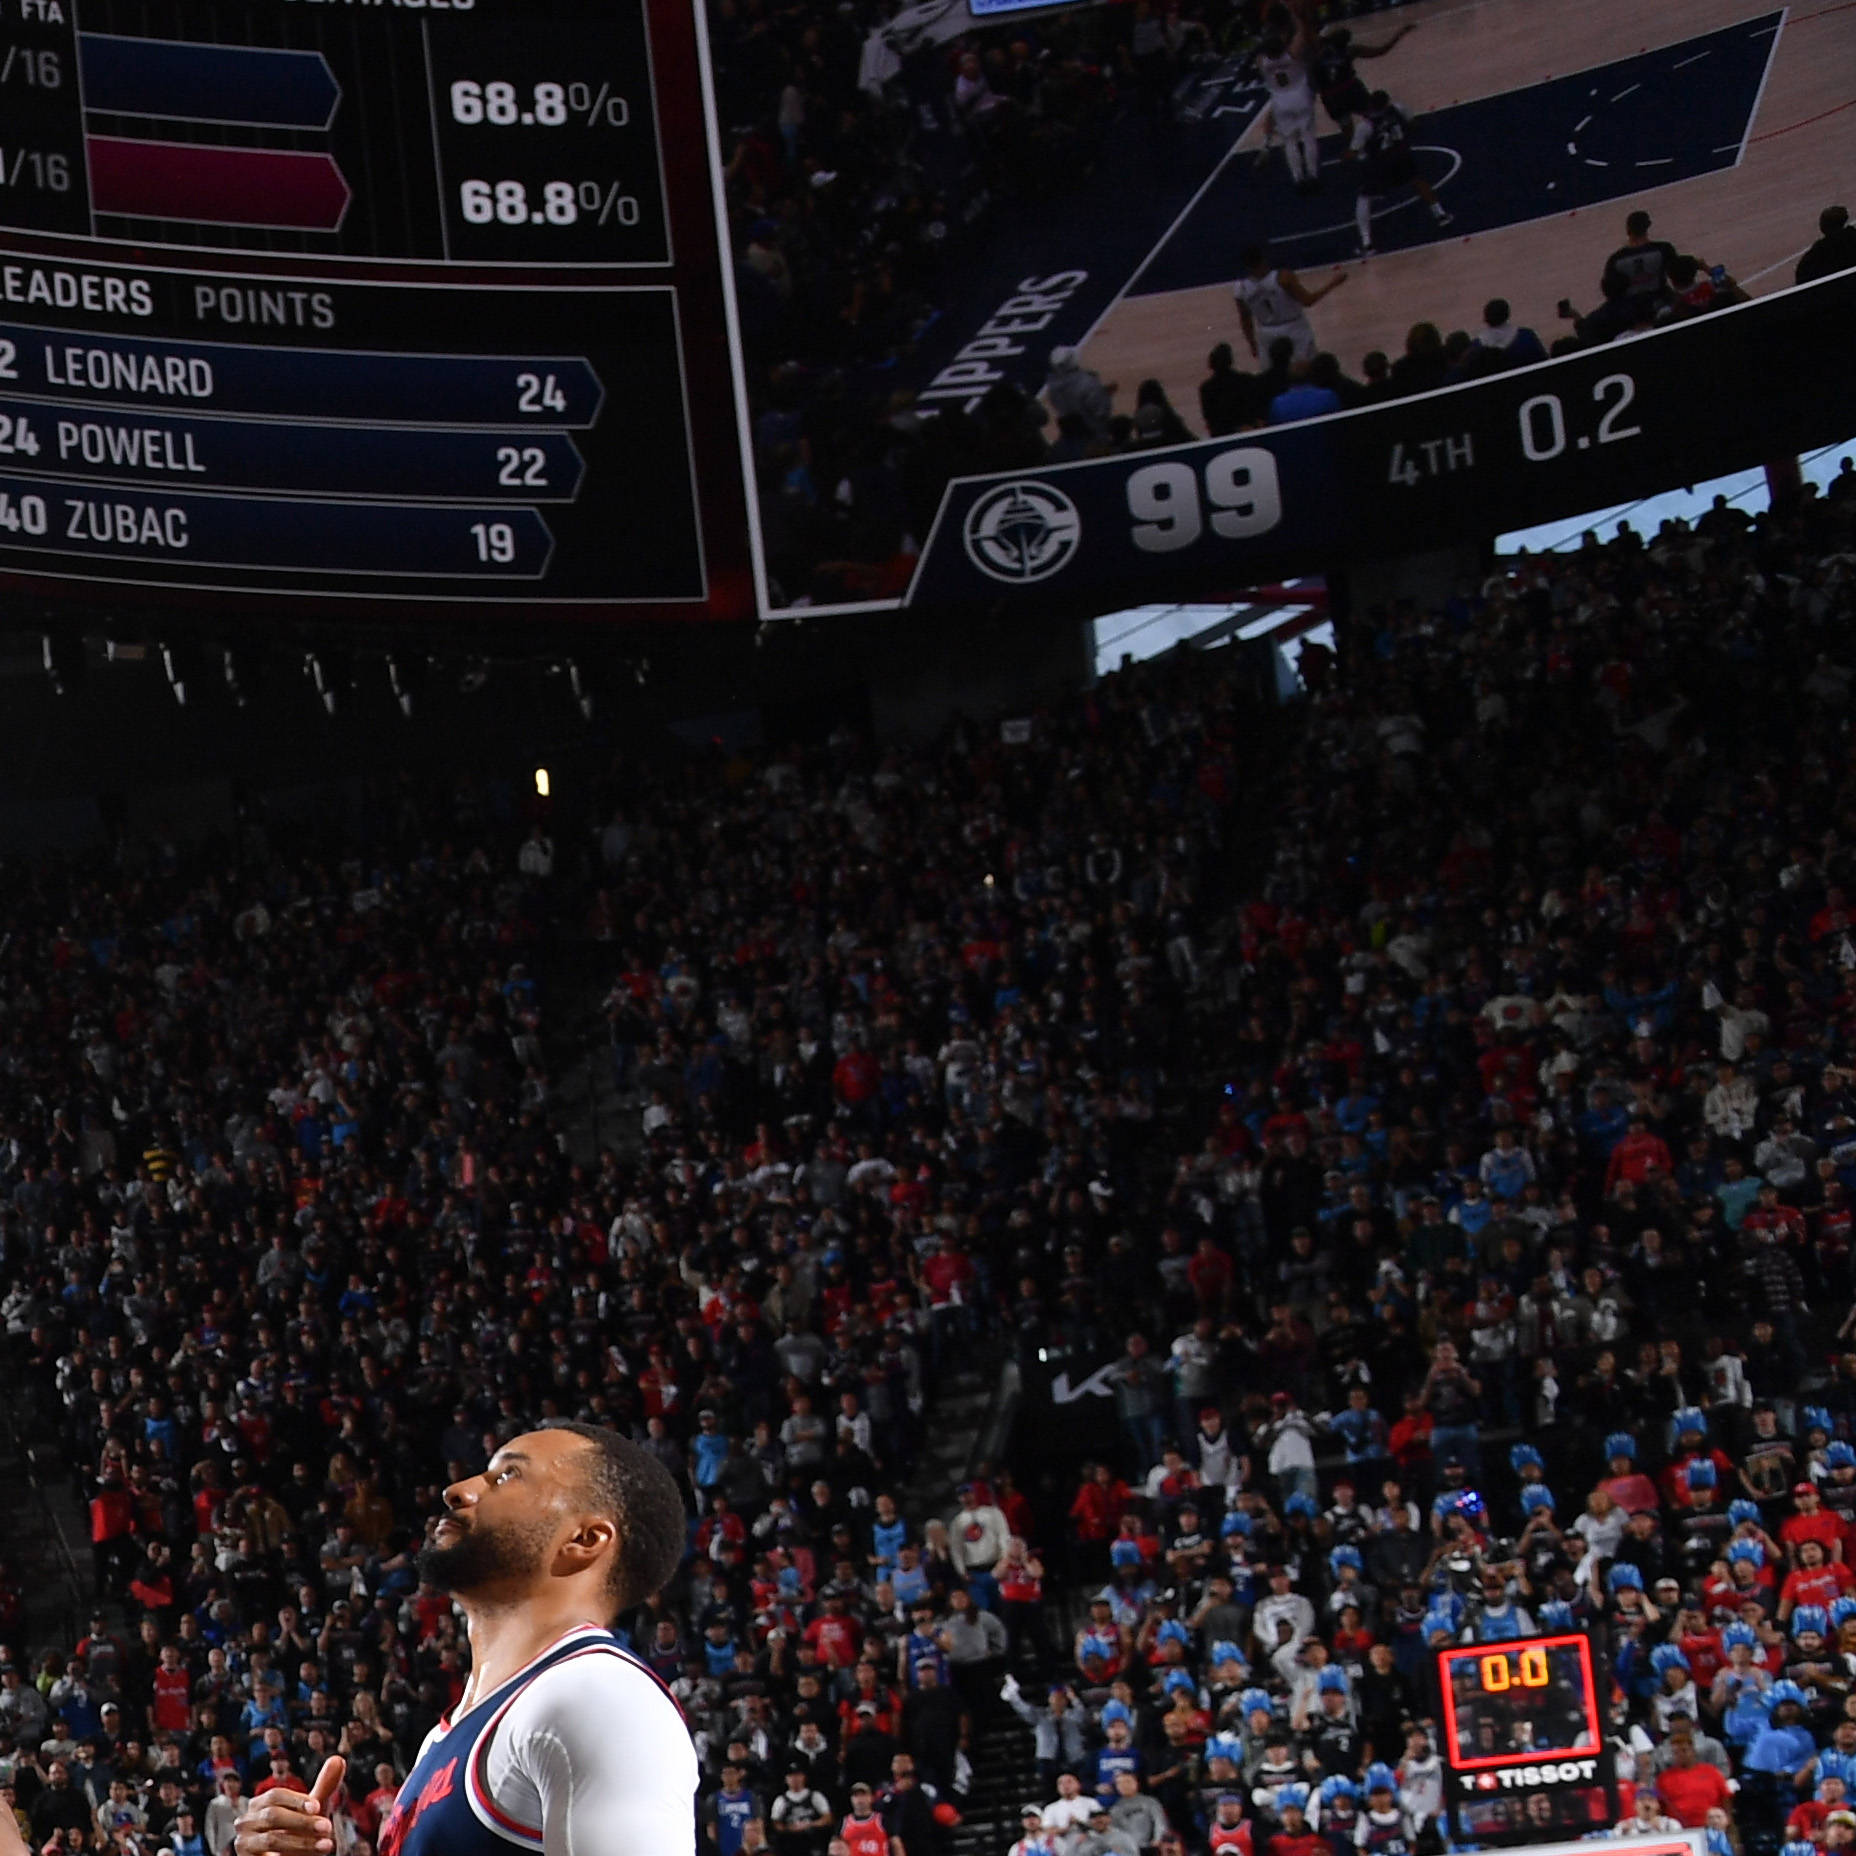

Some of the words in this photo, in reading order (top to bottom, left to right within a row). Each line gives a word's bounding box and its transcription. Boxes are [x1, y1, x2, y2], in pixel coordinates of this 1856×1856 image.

[451, 81, 630, 128] 68.8%
[460, 179, 640, 226] 68.8%
[195, 285, 336, 329] POINTS
[45, 346, 214, 398] LEONARD
[516, 375, 567, 413] 24
[59, 422, 206, 473] POWELL
[496, 449, 549, 487] 22
[1126, 447, 1283, 553] 99
[1387, 431, 1475, 487] 4TH
[1518, 374, 1642, 464] 0.2
[65, 499, 189, 549] ZUBAC
[470, 523, 515, 563] 19
[1481, 1649, 1549, 1691] 0.0
[1499, 1759, 1596, 1787] TISSOT
